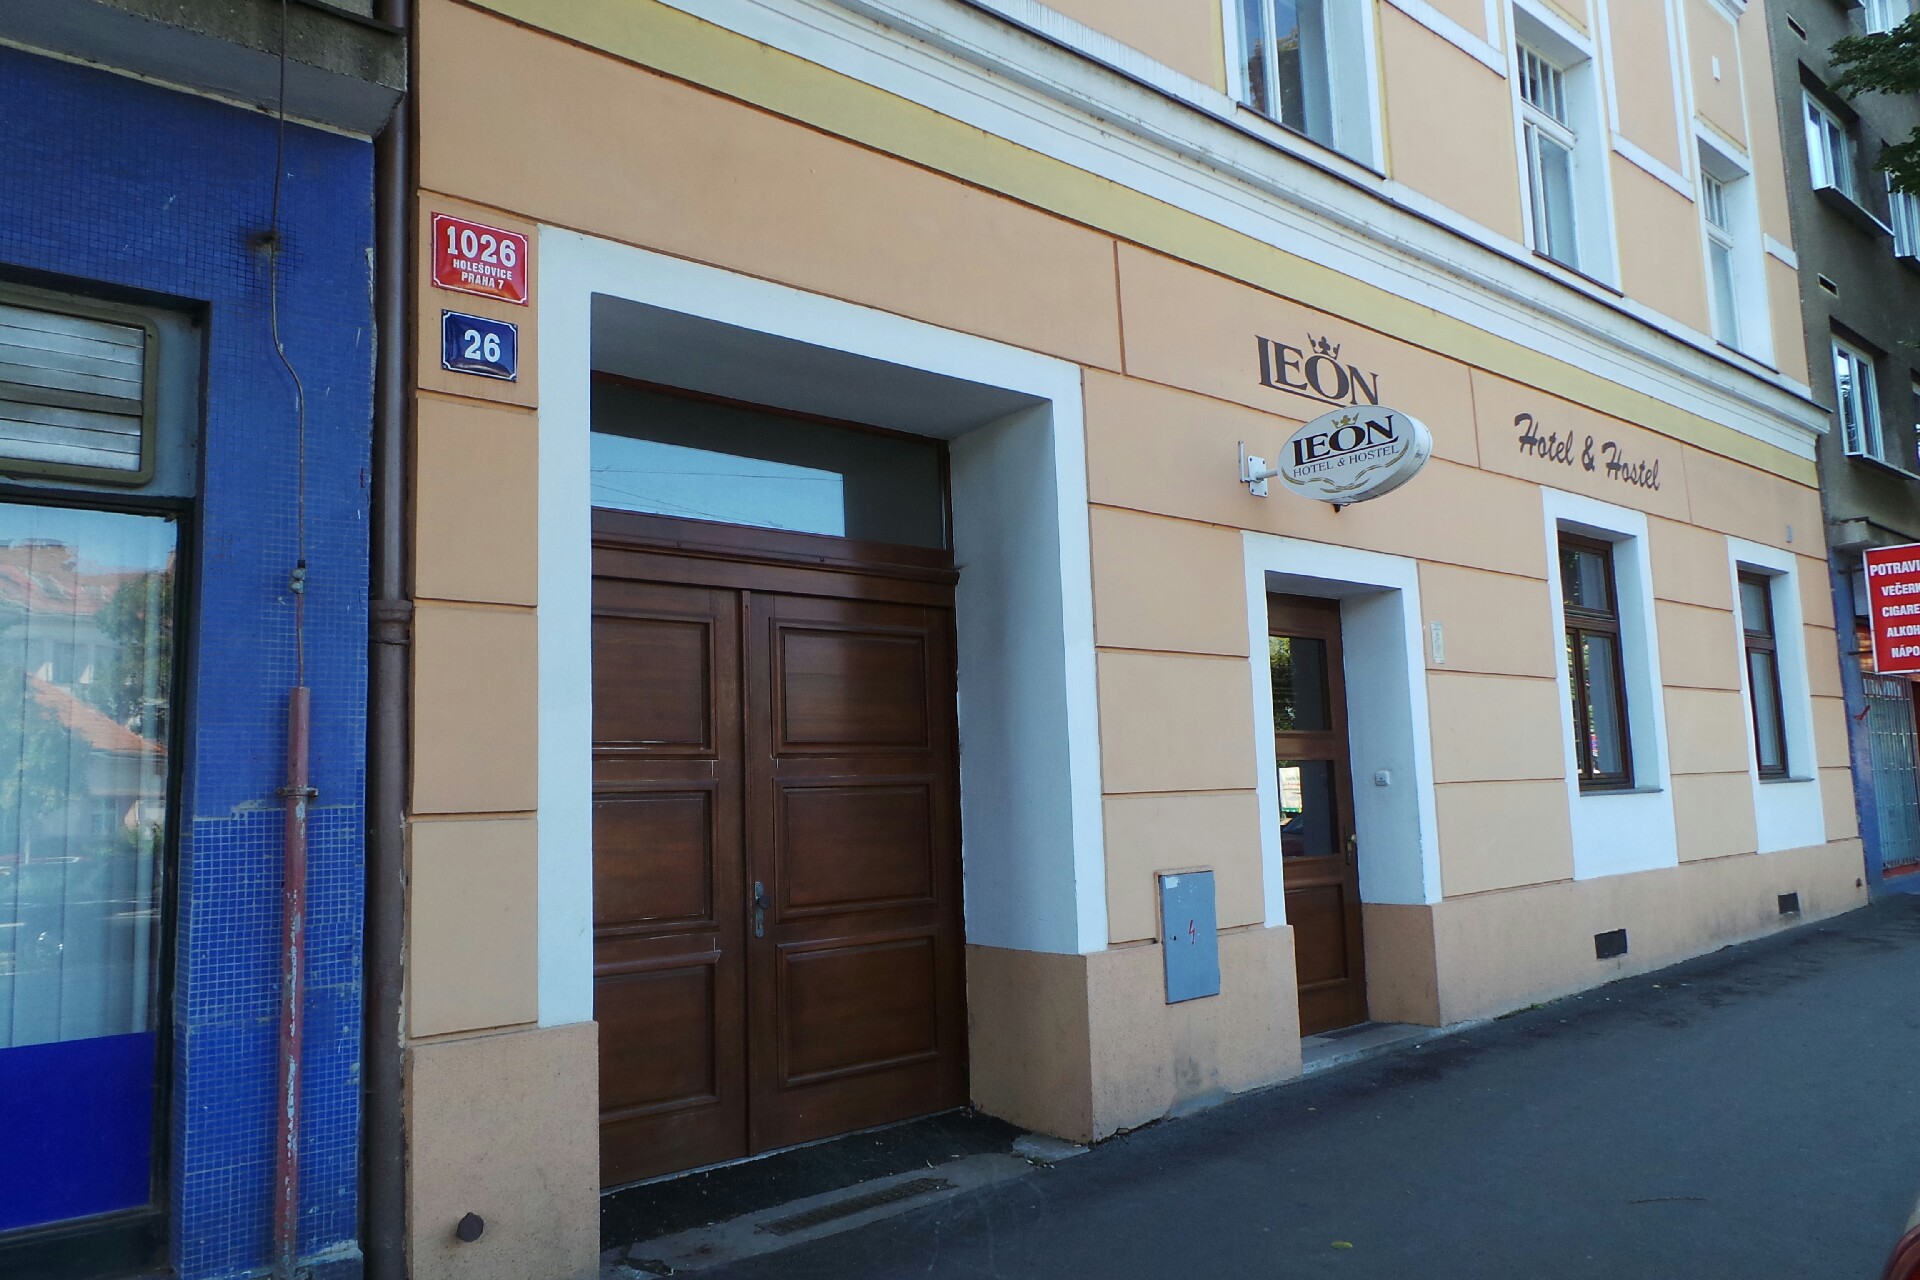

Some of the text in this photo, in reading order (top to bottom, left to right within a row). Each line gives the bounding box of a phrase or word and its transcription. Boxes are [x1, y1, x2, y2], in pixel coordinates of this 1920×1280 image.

[447, 226, 516, 267] 1026
[452, 258, 513, 281] HOLEŠOVICE
[461, 271, 505, 290] PRAHA 7
[464, 329, 501, 363] 26
[1254, 334, 1379, 408] LEON
[1291, 414, 1399, 467] LEON
[1514, 412, 1660, 491] Hotel & Hostel
[1292, 460, 1334, 478] HOTEL
[1337, 457, 1345, 467] &
[1349, 445, 1400, 465] HOSTEL
[1870, 560, 1920, 576] POTRAVI
[1882, 603, 1920, 618] CIGARE
[1887, 624, 1920, 638] ALKOH
